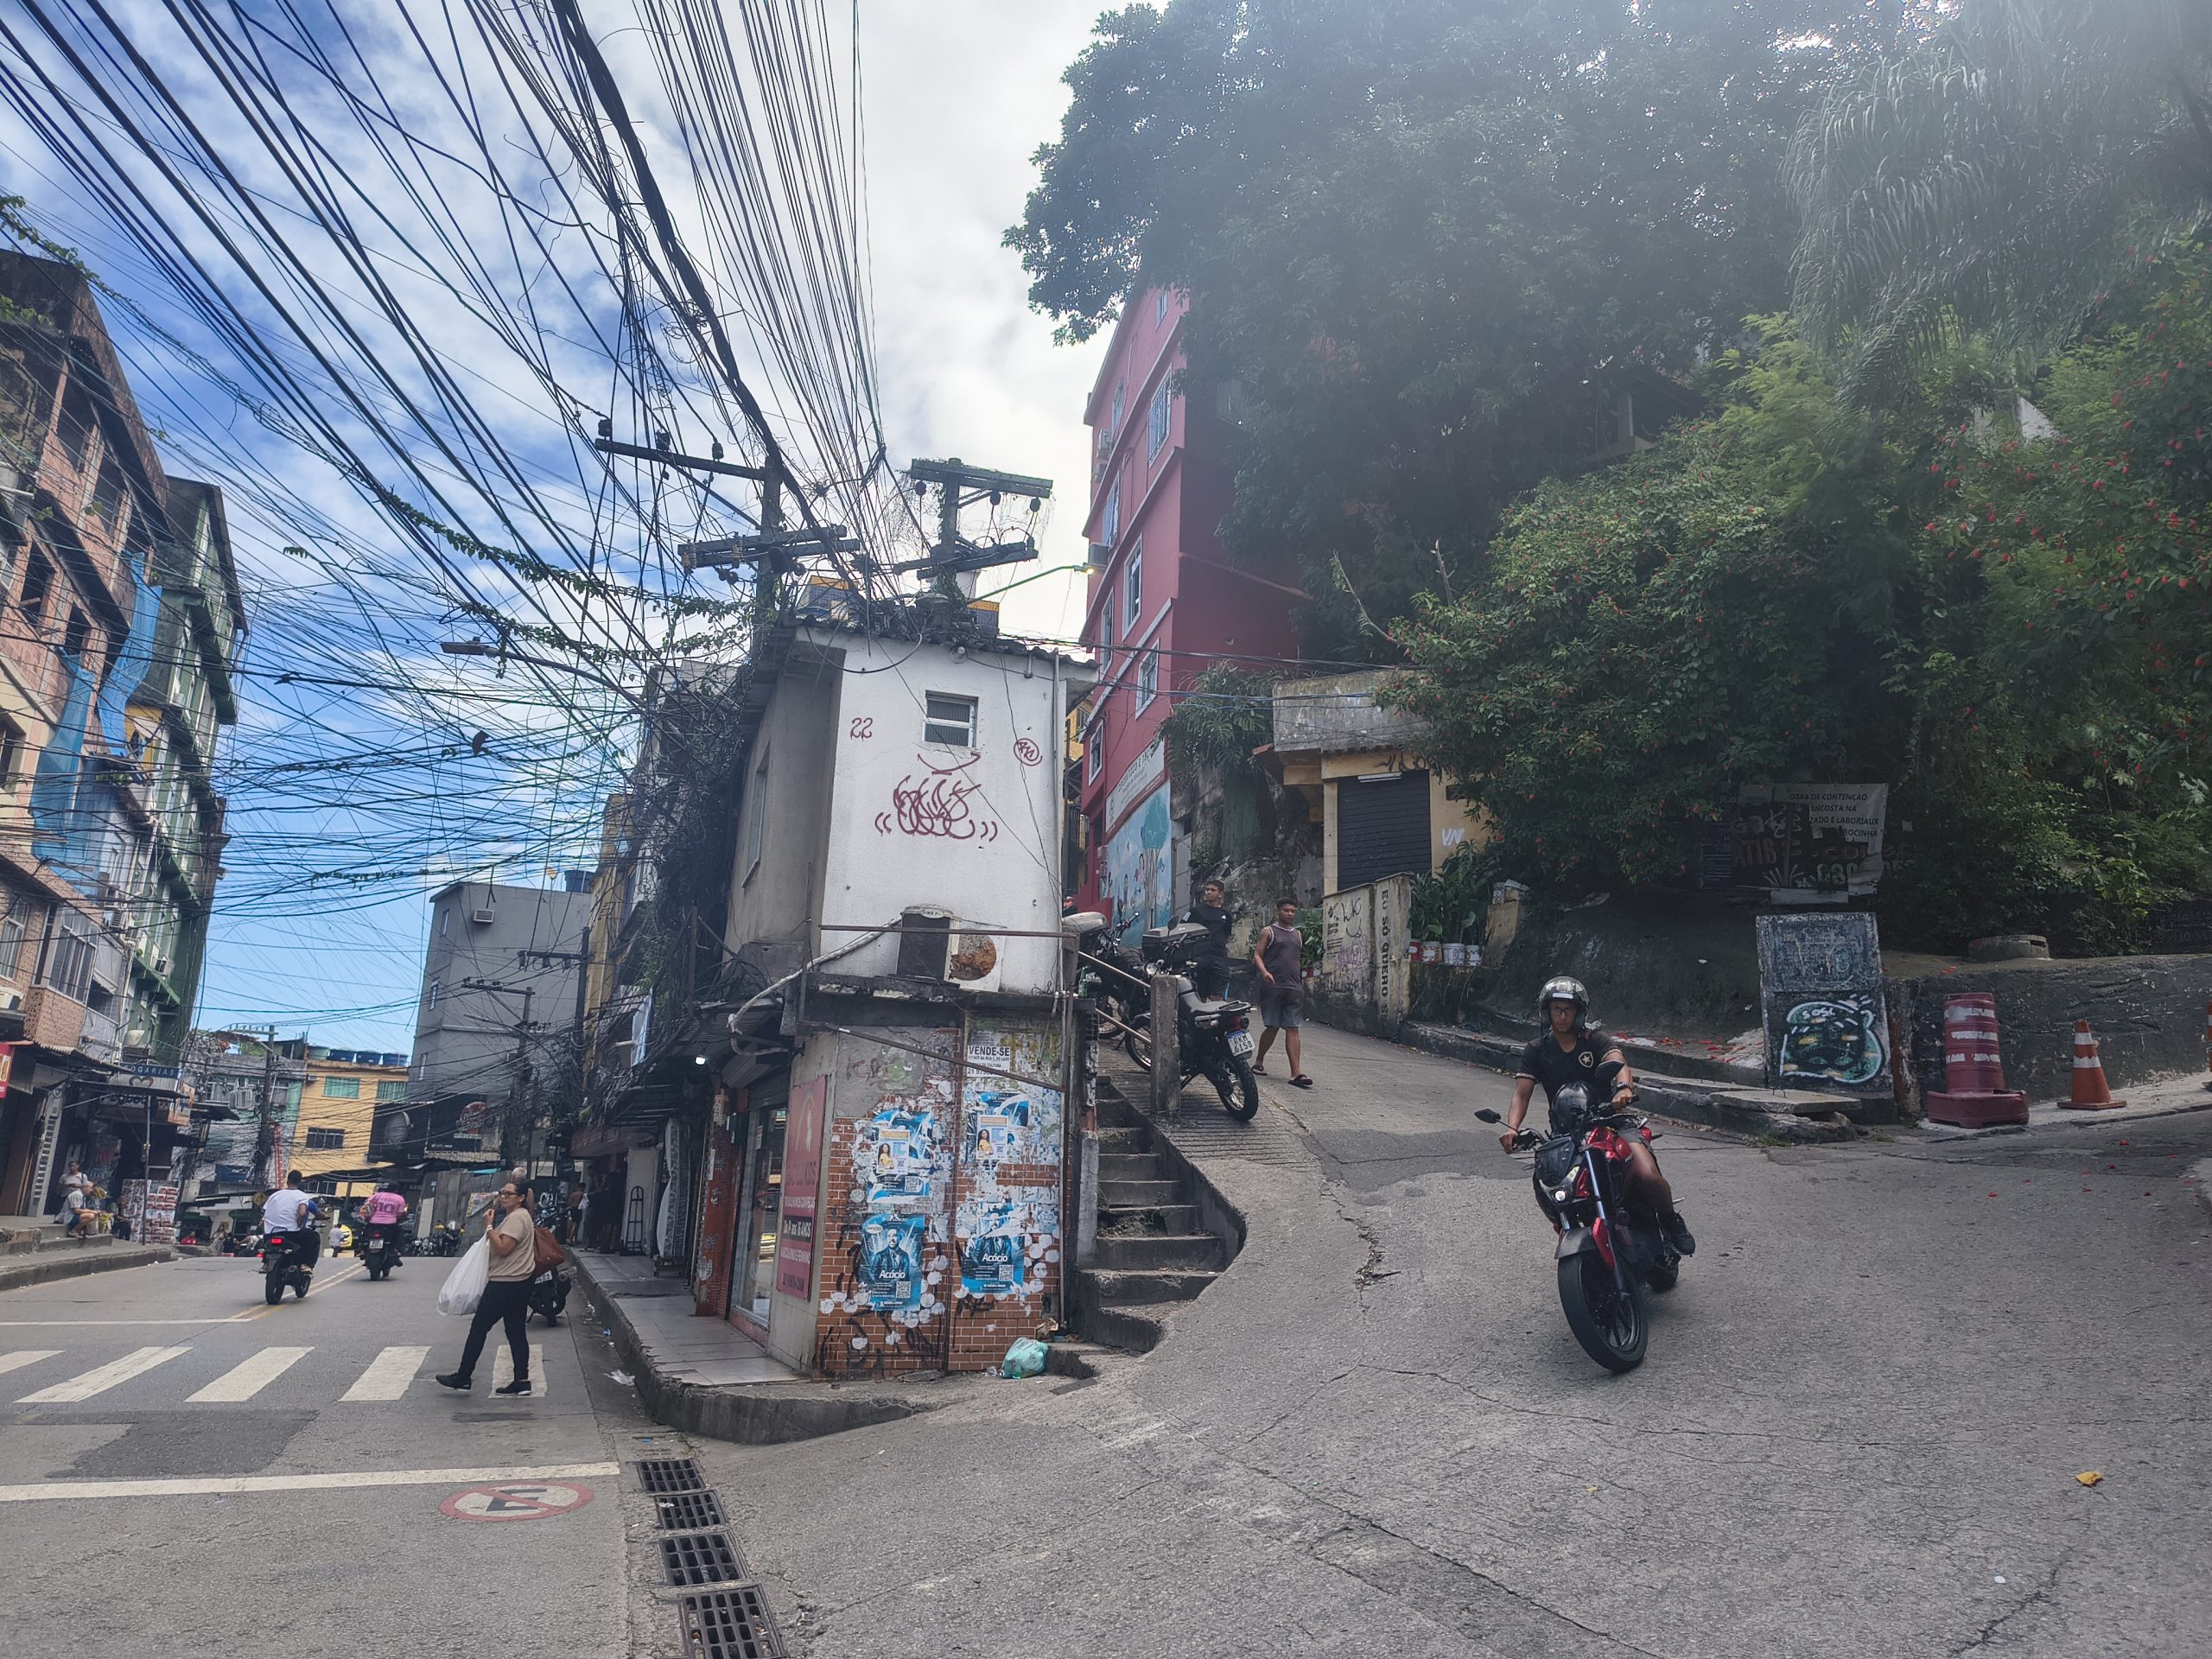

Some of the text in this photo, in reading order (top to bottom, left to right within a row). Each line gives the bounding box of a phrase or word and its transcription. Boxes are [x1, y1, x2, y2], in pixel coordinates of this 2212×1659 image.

[849, 717, 874, 741] 22
[969, 1046, 1009, 1056] VENDE-SE
[982, 1253, 1008, 1262] Acácio
[879, 1269, 906, 1280] Acácio
